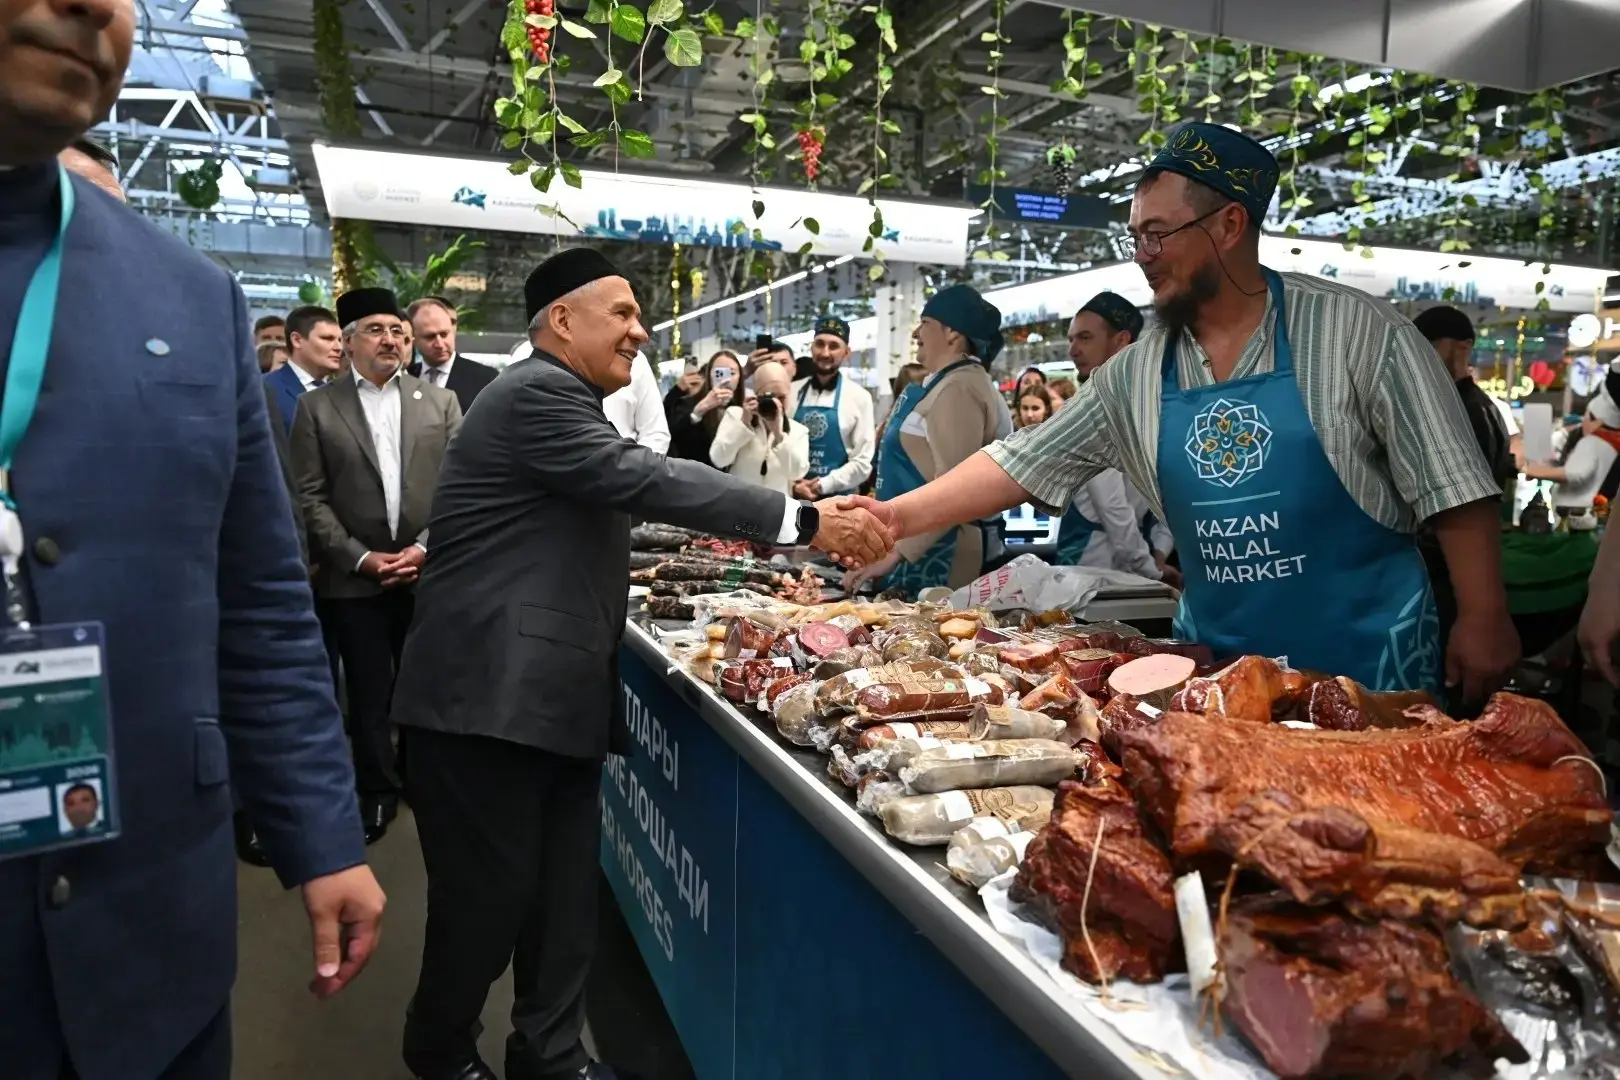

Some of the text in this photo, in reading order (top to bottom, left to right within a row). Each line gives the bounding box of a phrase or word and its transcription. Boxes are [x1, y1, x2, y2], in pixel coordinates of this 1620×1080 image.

[1195, 511, 1280, 537] KAZAN
[1200, 537, 1280, 560] HALAL
[1206, 555, 1306, 583] MARKET
[620, 678, 679, 791] ТЛАРЫ
[604, 752, 709, 934] ИЕ ЛОШАДИ
[602, 795, 674, 962] AR HORSES
